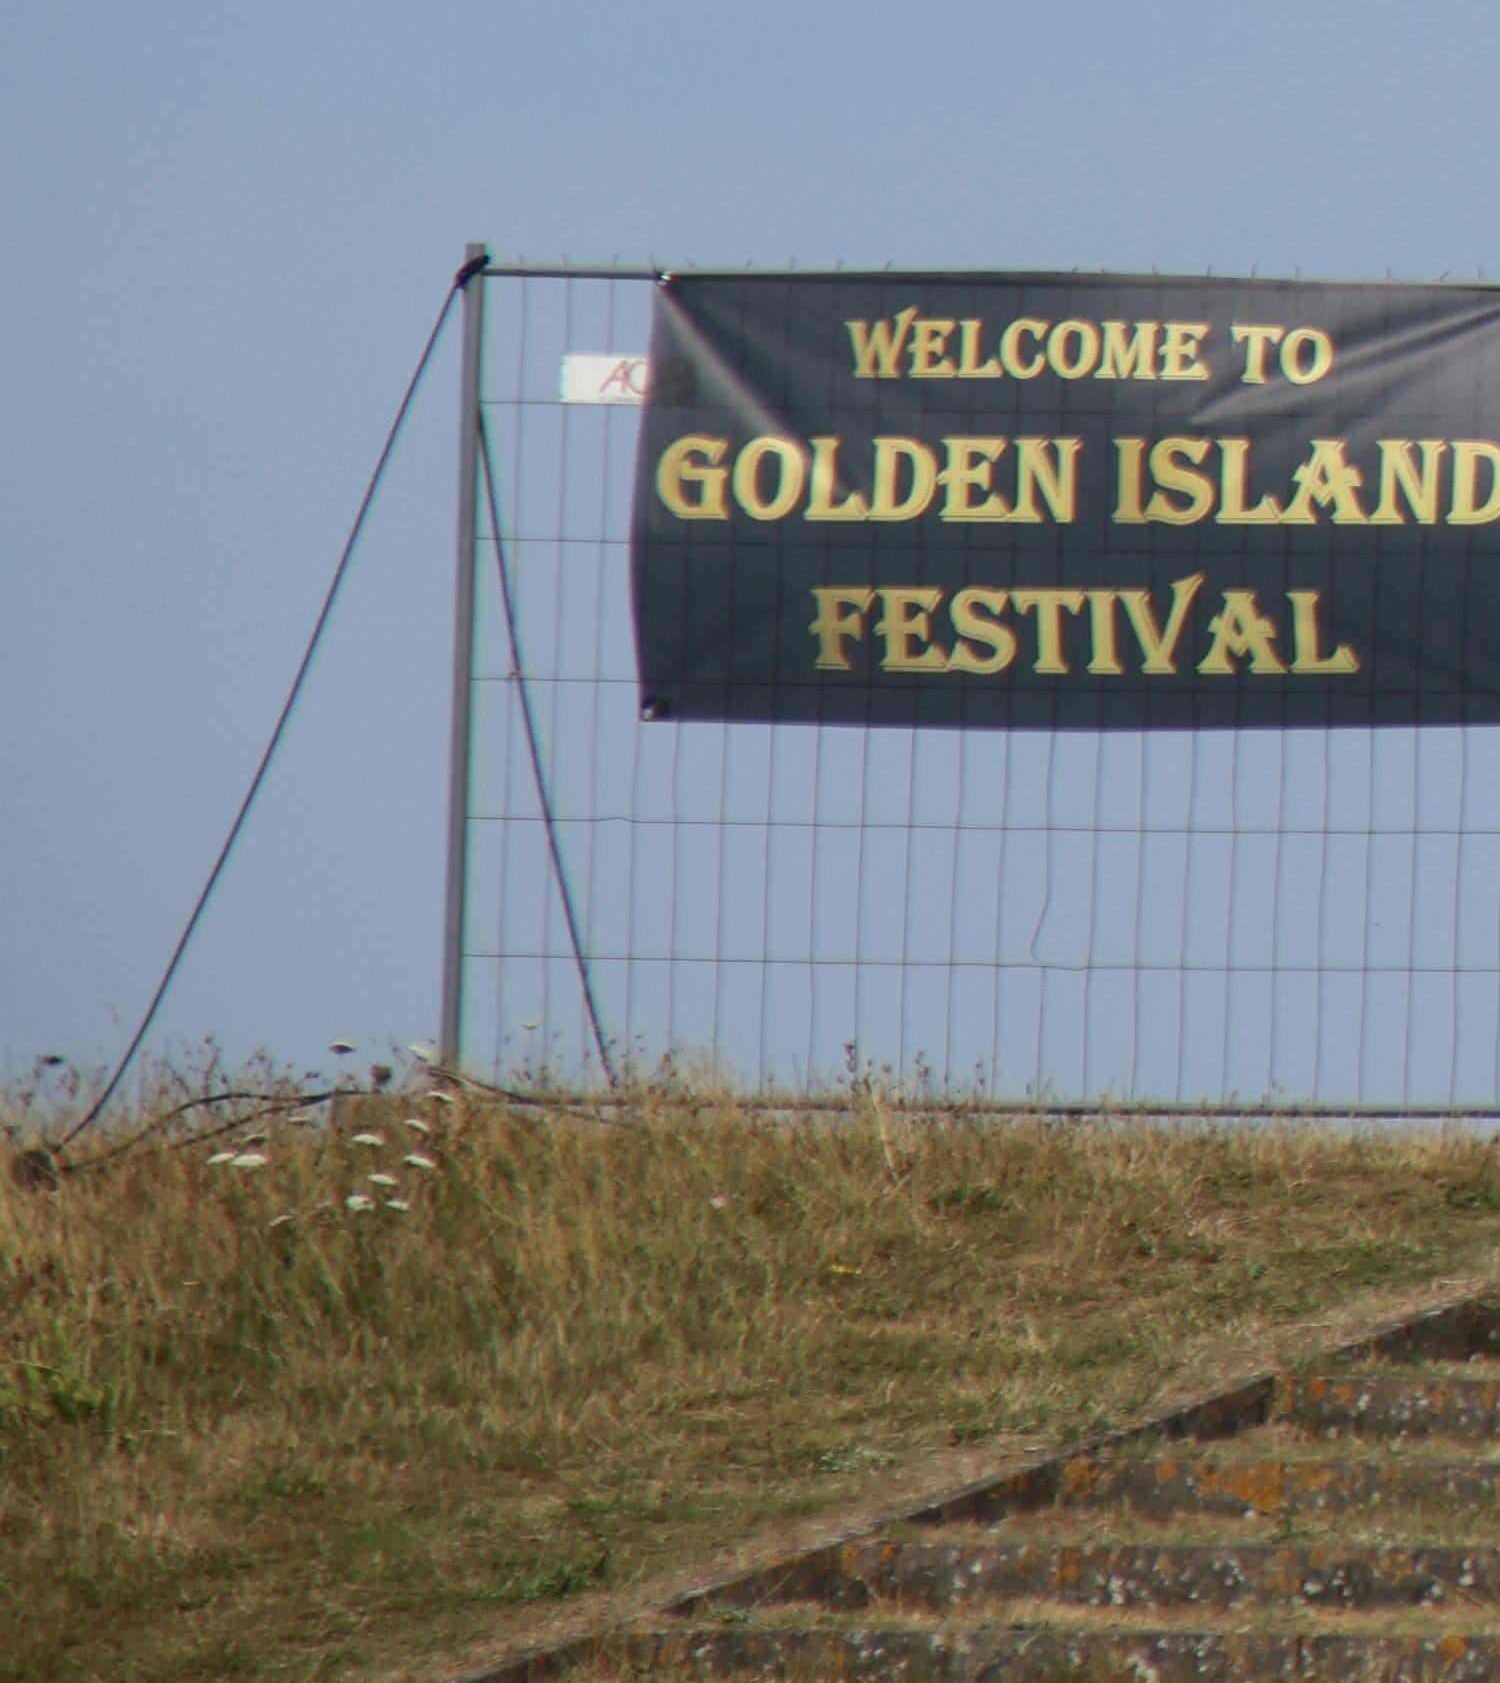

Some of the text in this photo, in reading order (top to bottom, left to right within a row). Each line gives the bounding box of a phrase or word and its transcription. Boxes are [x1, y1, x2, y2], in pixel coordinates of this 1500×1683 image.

[846, 305, 1332, 385] WELCOME TO
[655, 434, 1084, 524] GOLDEN
[808, 573, 1360, 675] FESTIVAL
